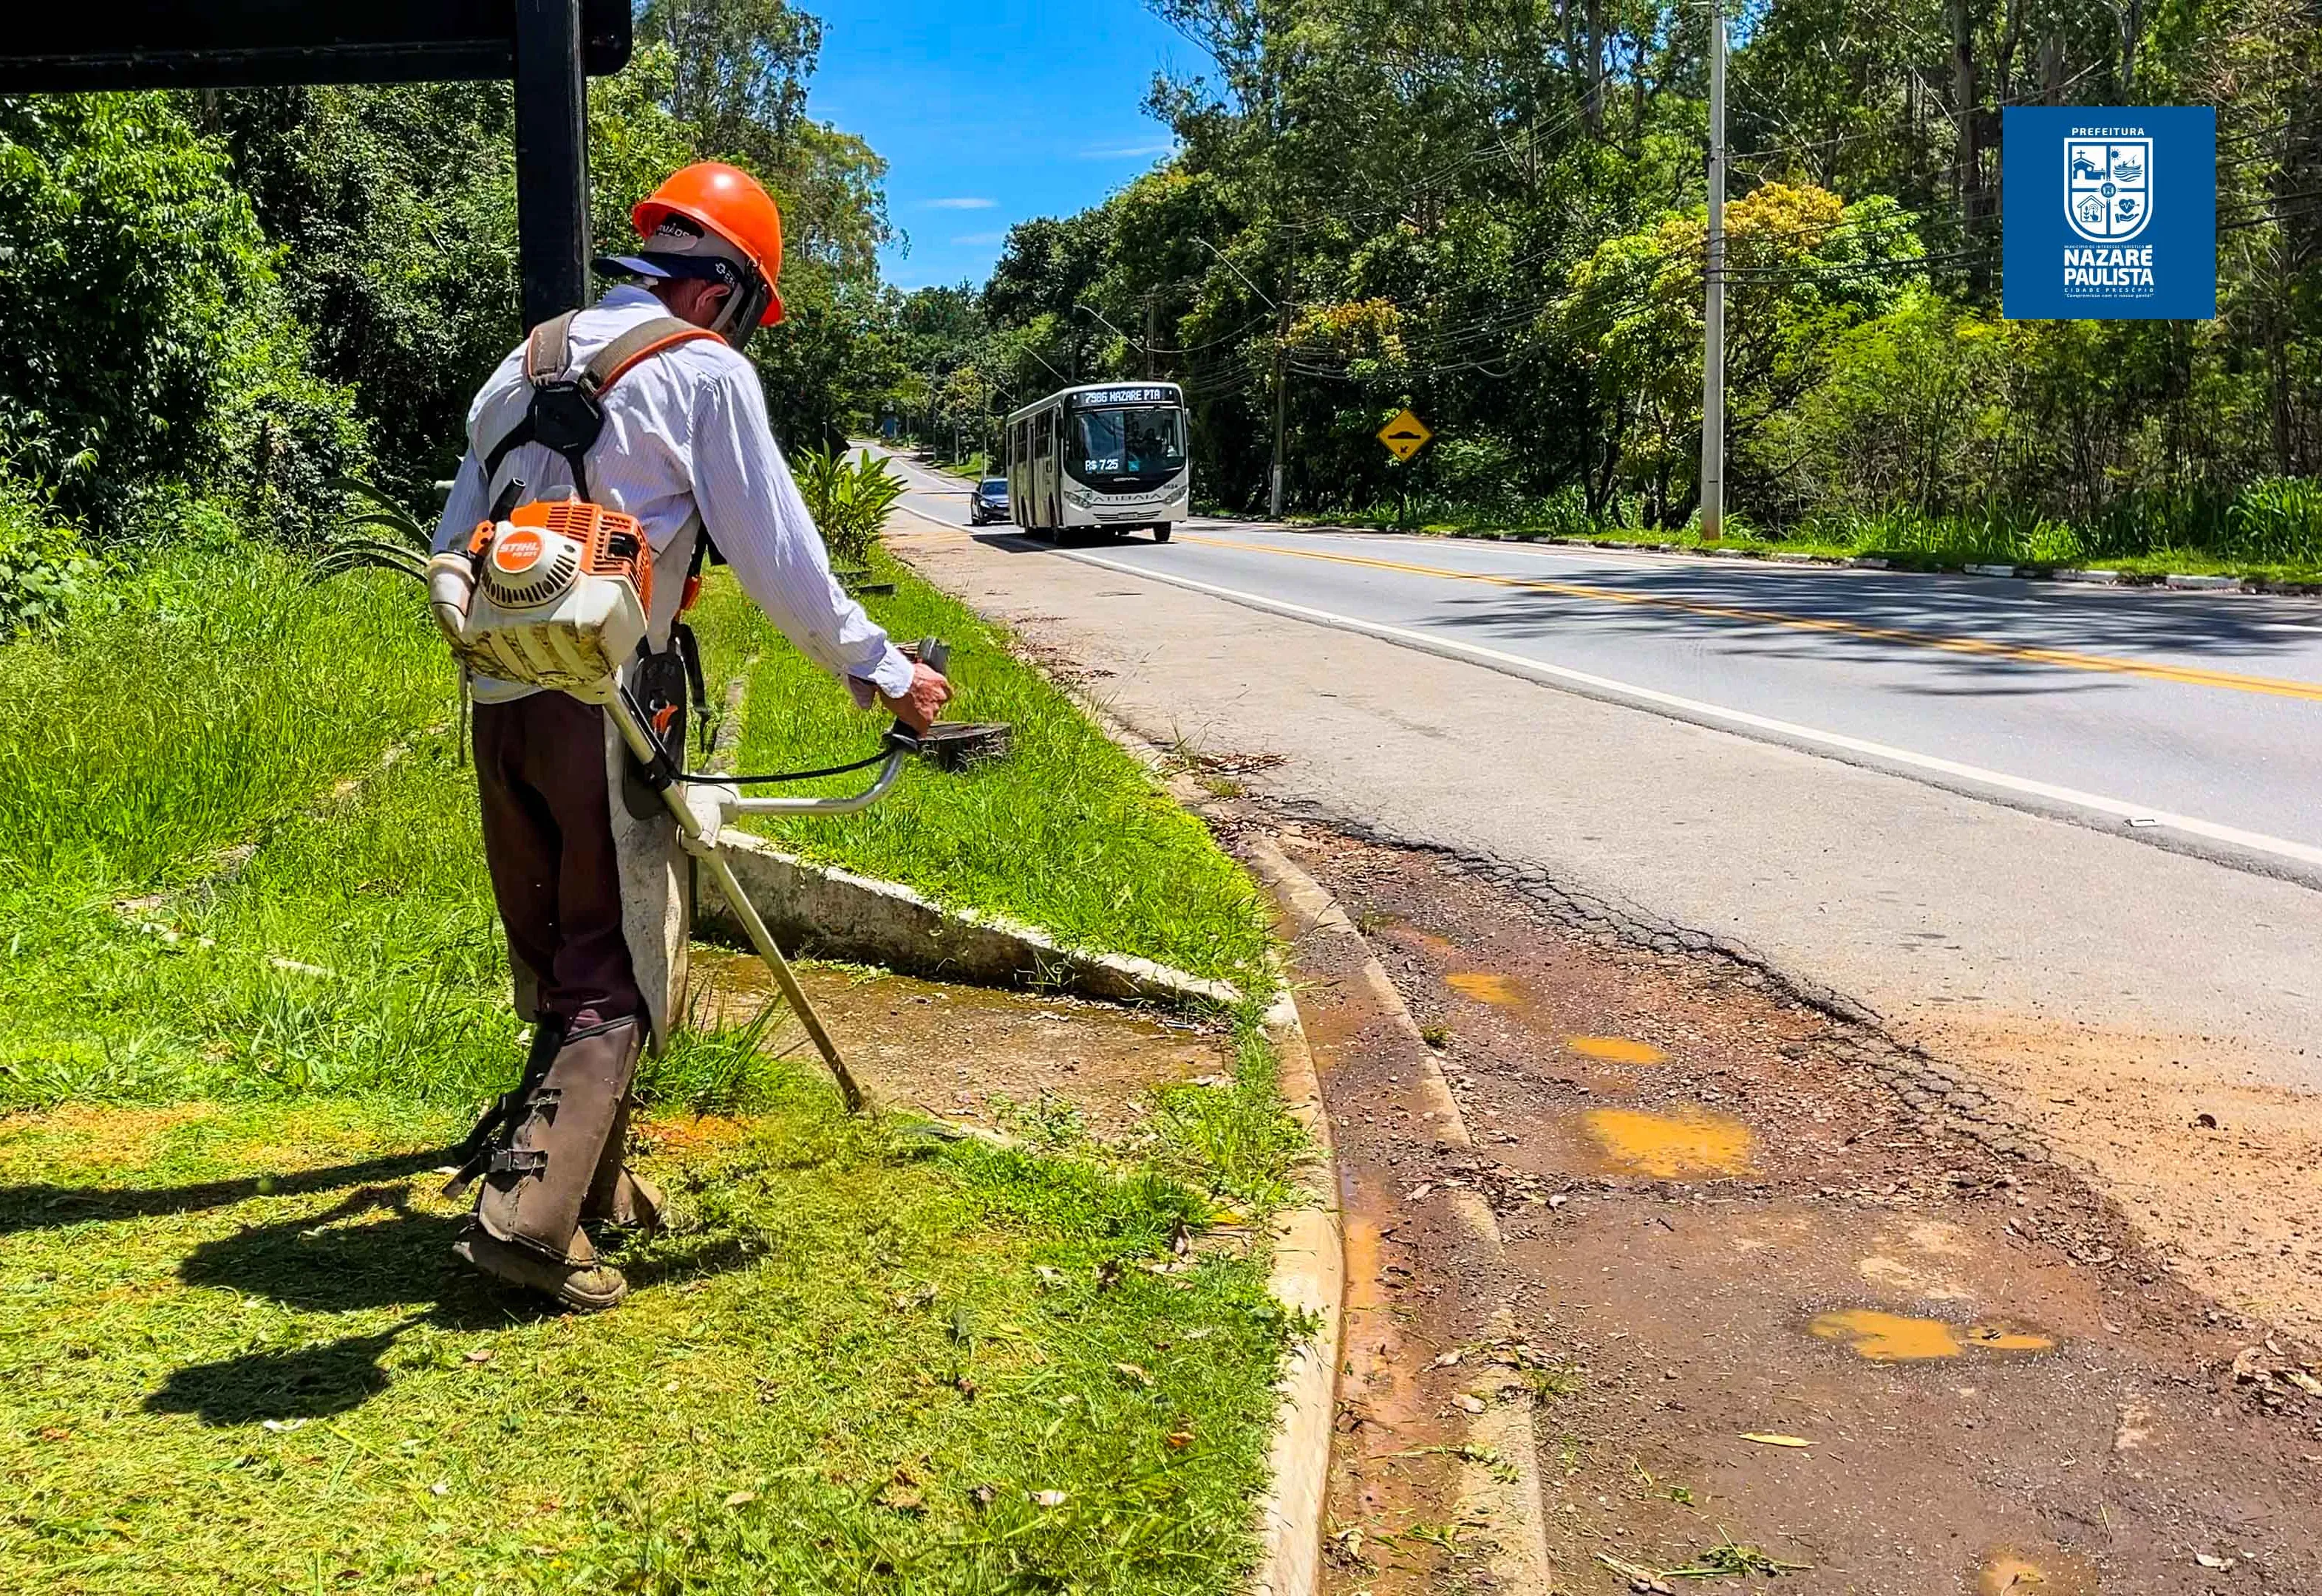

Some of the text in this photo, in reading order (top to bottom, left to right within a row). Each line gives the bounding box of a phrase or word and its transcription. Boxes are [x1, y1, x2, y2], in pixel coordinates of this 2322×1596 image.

[1086, 389, 1160, 403] 7986 NAZARE PTA
[1085, 460, 1097, 471] R$
[1093, 493, 1161, 502] ATIBAIA
[498, 542, 540, 553] STIHL
